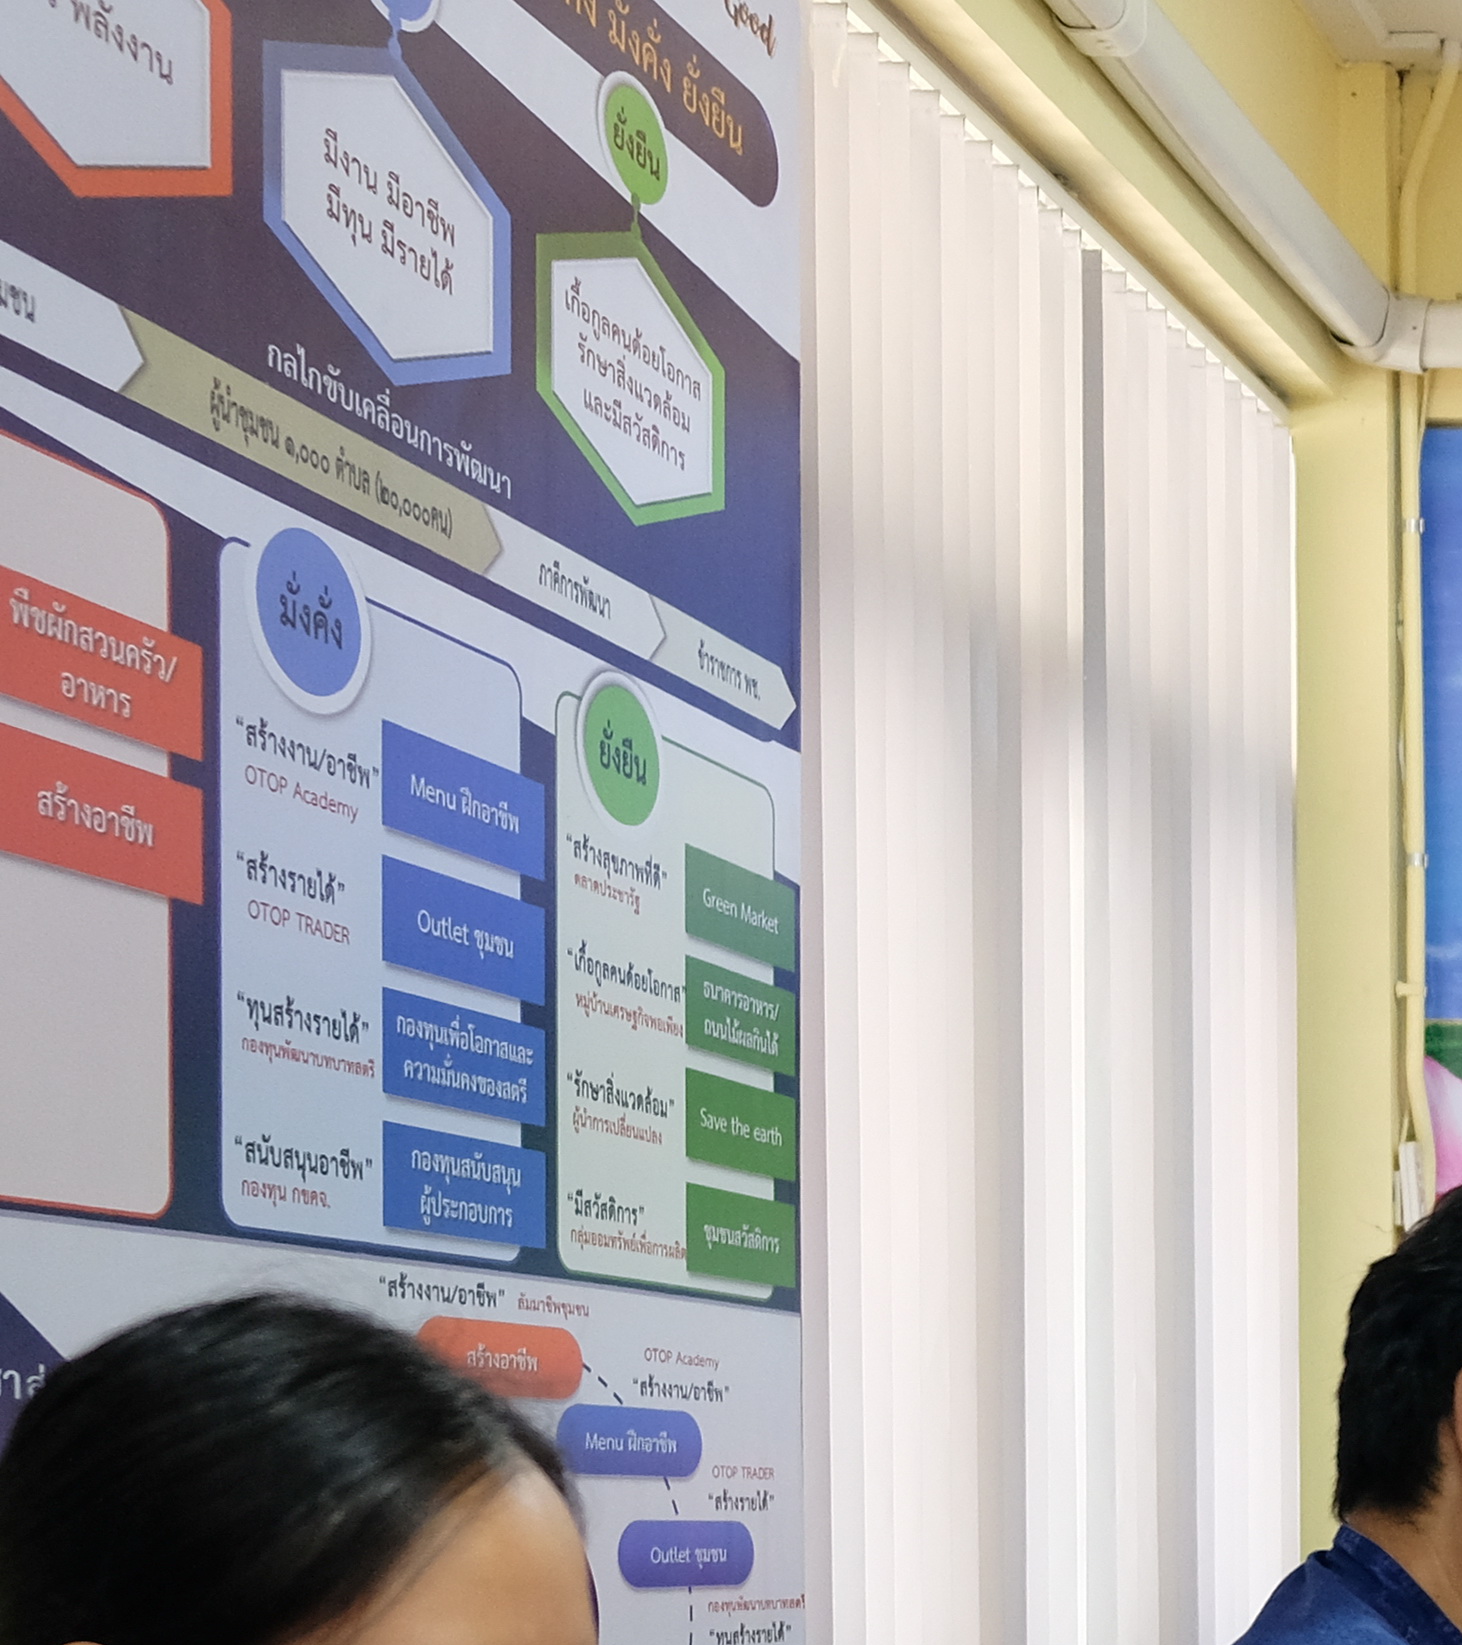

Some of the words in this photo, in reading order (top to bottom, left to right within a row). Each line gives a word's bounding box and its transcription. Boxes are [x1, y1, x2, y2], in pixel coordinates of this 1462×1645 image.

[608, 0, 671, 93] มังคั่ง
[683, 56, 743, 155] ยั่งยืน
[613, 107, 660, 182] ยั่งยืน
[323, 128, 378, 195] มีงาน
[386, 171, 456, 248] มีอาชีพ
[326, 184, 373, 246] มีทุน
[381, 219, 453, 296] มีรายได้
[565, 276, 701, 402] เกื้อกูลคนด้อยโอกาส
[577, 333, 691, 434] รักษาสิ่งแวดล้อม
[209, 376, 279, 448] ผู้นำชุมชน
[335, 447, 371, 495] ตำบล
[267, 343, 512, 500] กลไกขับเคลื่อนการพัฒนา
[583, 387, 686, 471] และมีสวัสดิการ
[279, 570, 343, 650] มั่งคั่ง
[538, 560, 612, 621] ภาคีการพัฒนา
[9, 587, 178, 683] พืชผักสวนครัว/
[61, 672, 133, 719] อาหาร
[599, 719, 647, 786] ยั่งยืน
[37, 780, 155, 847] สร้างอาชีพ
[245, 764, 288, 794] OTOP
[293, 782, 358, 824] Academy
[410, 774, 456, 812] Menu
[461, 787, 520, 835] ฝึกอาชีพ
[247, 900, 291, 926] OTOP
[296, 912, 350, 945] TRADER
[418, 909, 469, 947] Outlet
[474, 926, 514, 960] ชุมชน
[702, 888, 738, 918] Green
[740, 902, 780, 935] Market
[397, 1012, 534, 1066] กองทุนเพื่อโอกาสและ
[404, 1053, 528, 1104] ความมั่นคงของสตรี
[700, 1107, 727, 1132] Save
[731, 1117, 750, 1138] the
[753, 1122, 783, 1147] earth
[241, 1178, 287, 1206] กองทุน
[411, 1148, 521, 1194] กองทุนสนับสนุน
[420, 1185, 513, 1227] ผู้ประกอบการ
[704, 1224, 780, 1253] ชุมชนสวัสดิการ
[466, 1343, 539, 1372] สร้างอาชีพ
[643, 1347, 673, 1365] OTOP
[675, 1352, 720, 1371] Academy
[585, 1432, 624, 1452] Menu
[627, 1431, 677, 1454] ฝึกอาชีพ
[712, 1465, 738, 1479] OTOP
[740, 1466, 775, 1481] TRADER
[650, 1547, 690, 1564] Outlet
[695, 1548, 727, 1569] ชุมชน
